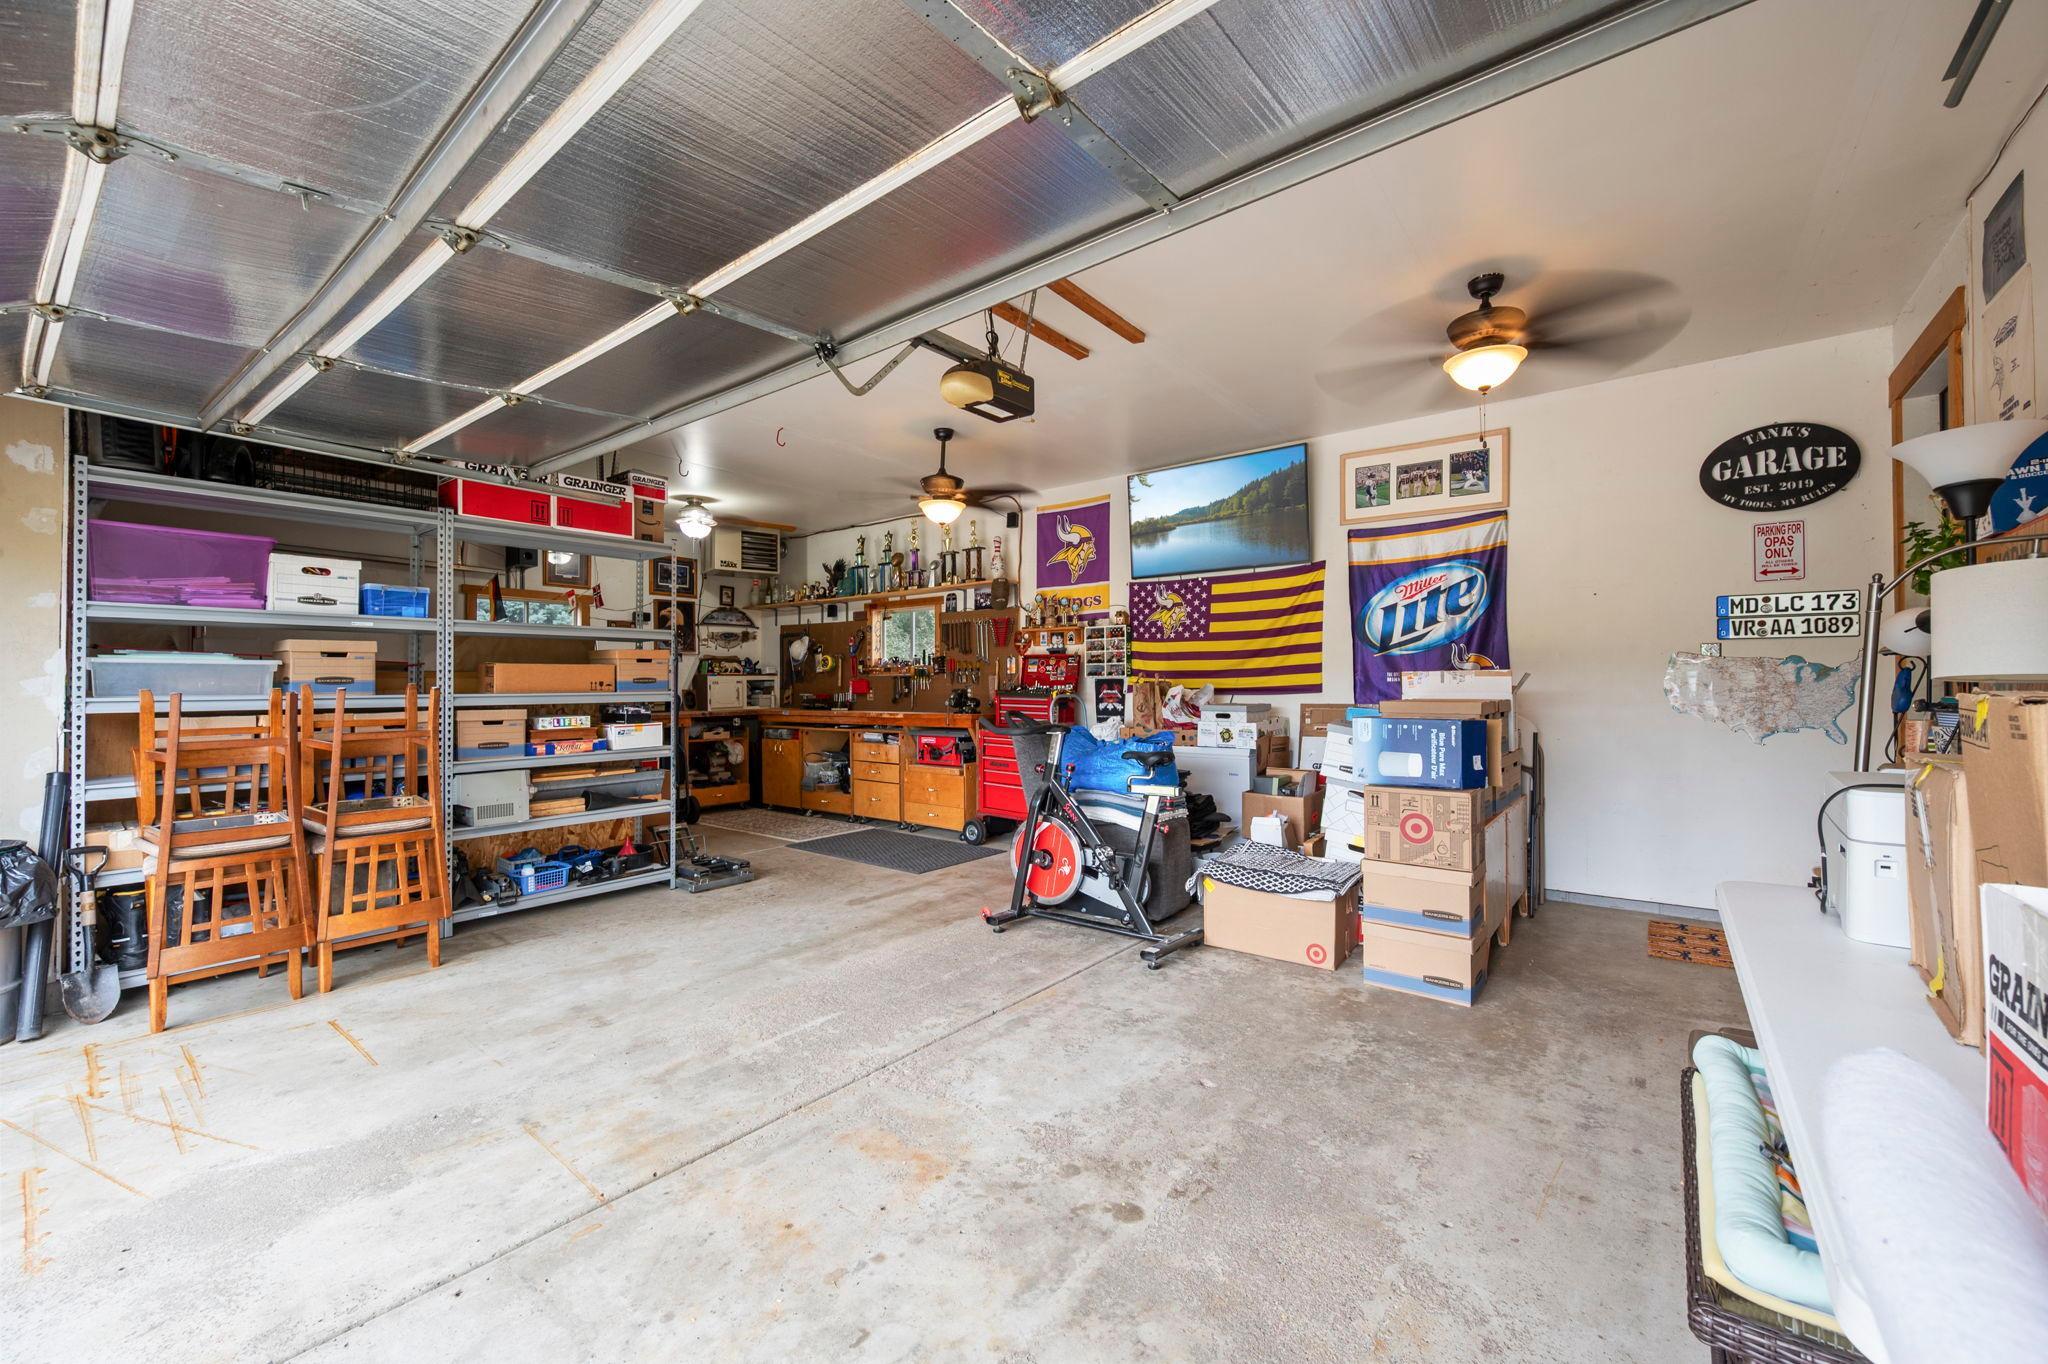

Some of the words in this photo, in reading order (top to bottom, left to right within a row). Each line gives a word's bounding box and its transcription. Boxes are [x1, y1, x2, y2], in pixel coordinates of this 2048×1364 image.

[1743, 426, 1811, 445] TANK'S
[1711, 446, 1847, 481] GARAGE
[564, 476, 626, 496] GRAINGER
[632, 475, 666, 486] GRAINGER
[1744, 484, 1774, 495] EST.
[1779, 479, 1814, 490] 2019
[1722, 493, 1736, 502] MY
[1781, 497, 1796, 506] MY
[1802, 482, 1836, 502] RULES
[1757, 525, 1786, 537] PARKING
[1787, 523, 1801, 534] FOR
[1764, 536, 1794, 547] OPAS
[1765, 547, 1794, 559] ONLY
[1395, 574, 1448, 599] Miller
[1730, 598, 1759, 614] MD
[1775, 596, 1804, 612] LC
[1811, 593, 1857, 611] 173
[1376, 574, 1480, 655] Lite
[1731, 620, 1756, 636] VR
[1770, 619, 1796, 635] AA
[1801, 616, 1854, 634] 1089
[553, 717, 577, 727] LIFE
